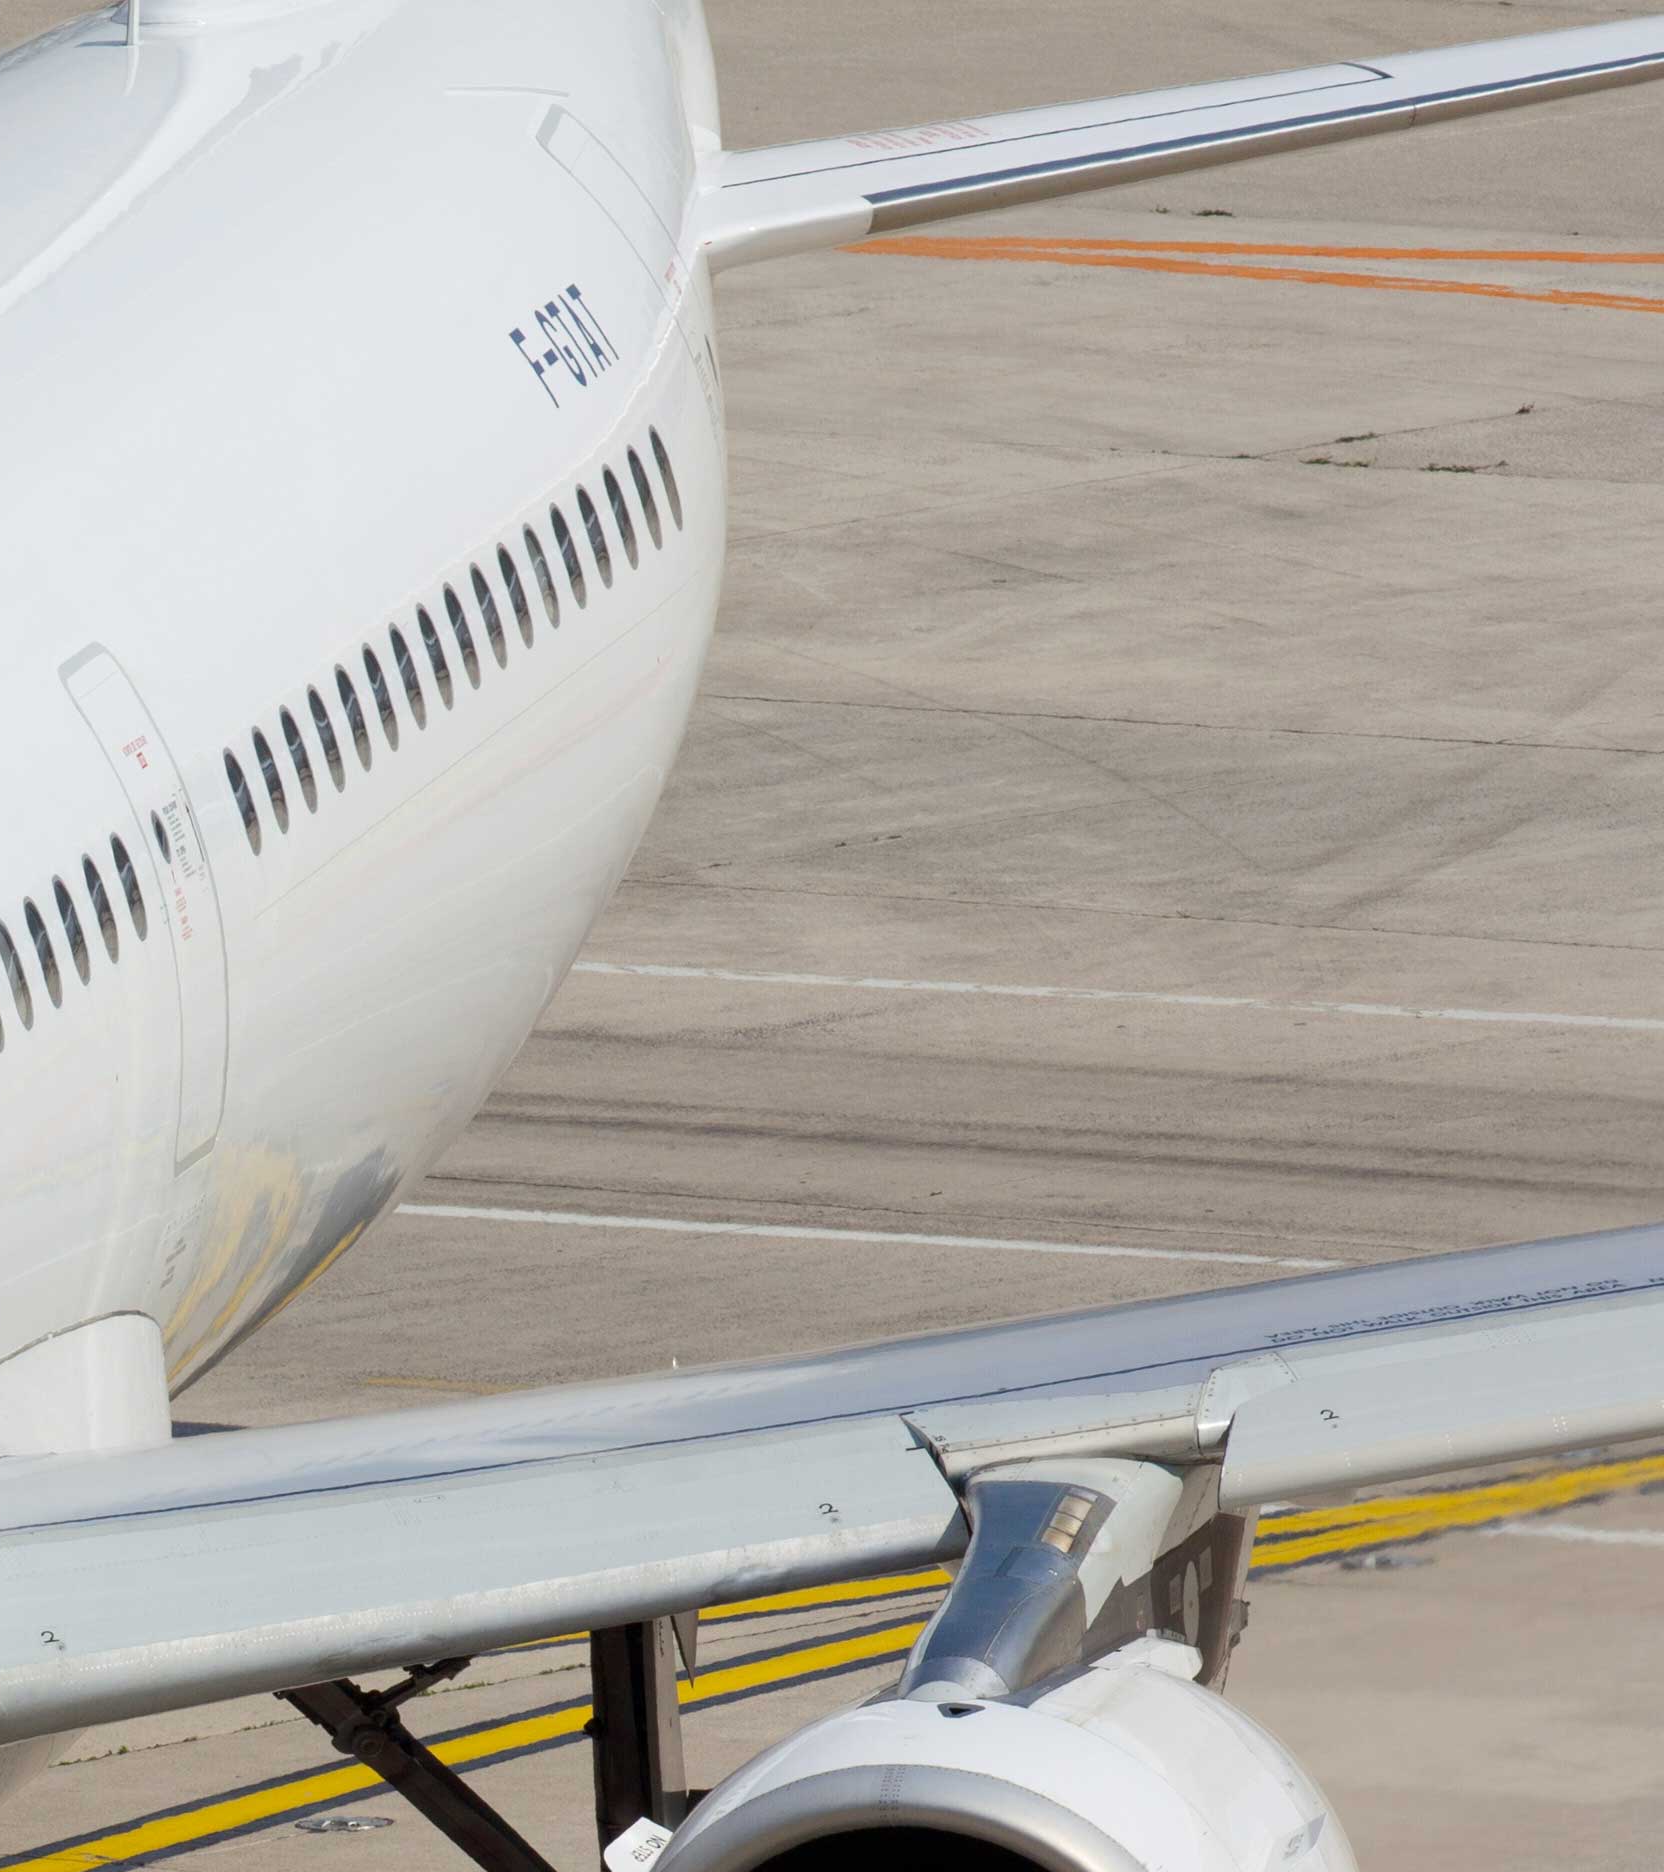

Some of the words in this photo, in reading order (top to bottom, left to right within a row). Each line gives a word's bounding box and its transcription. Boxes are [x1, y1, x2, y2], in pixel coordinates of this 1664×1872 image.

[508, 283, 620, 409] F-GTAT
[1320, 1409, 1340, 1421] 2
[818, 1503, 839, 1515] 2
[40, 1630, 60, 1643] 2
